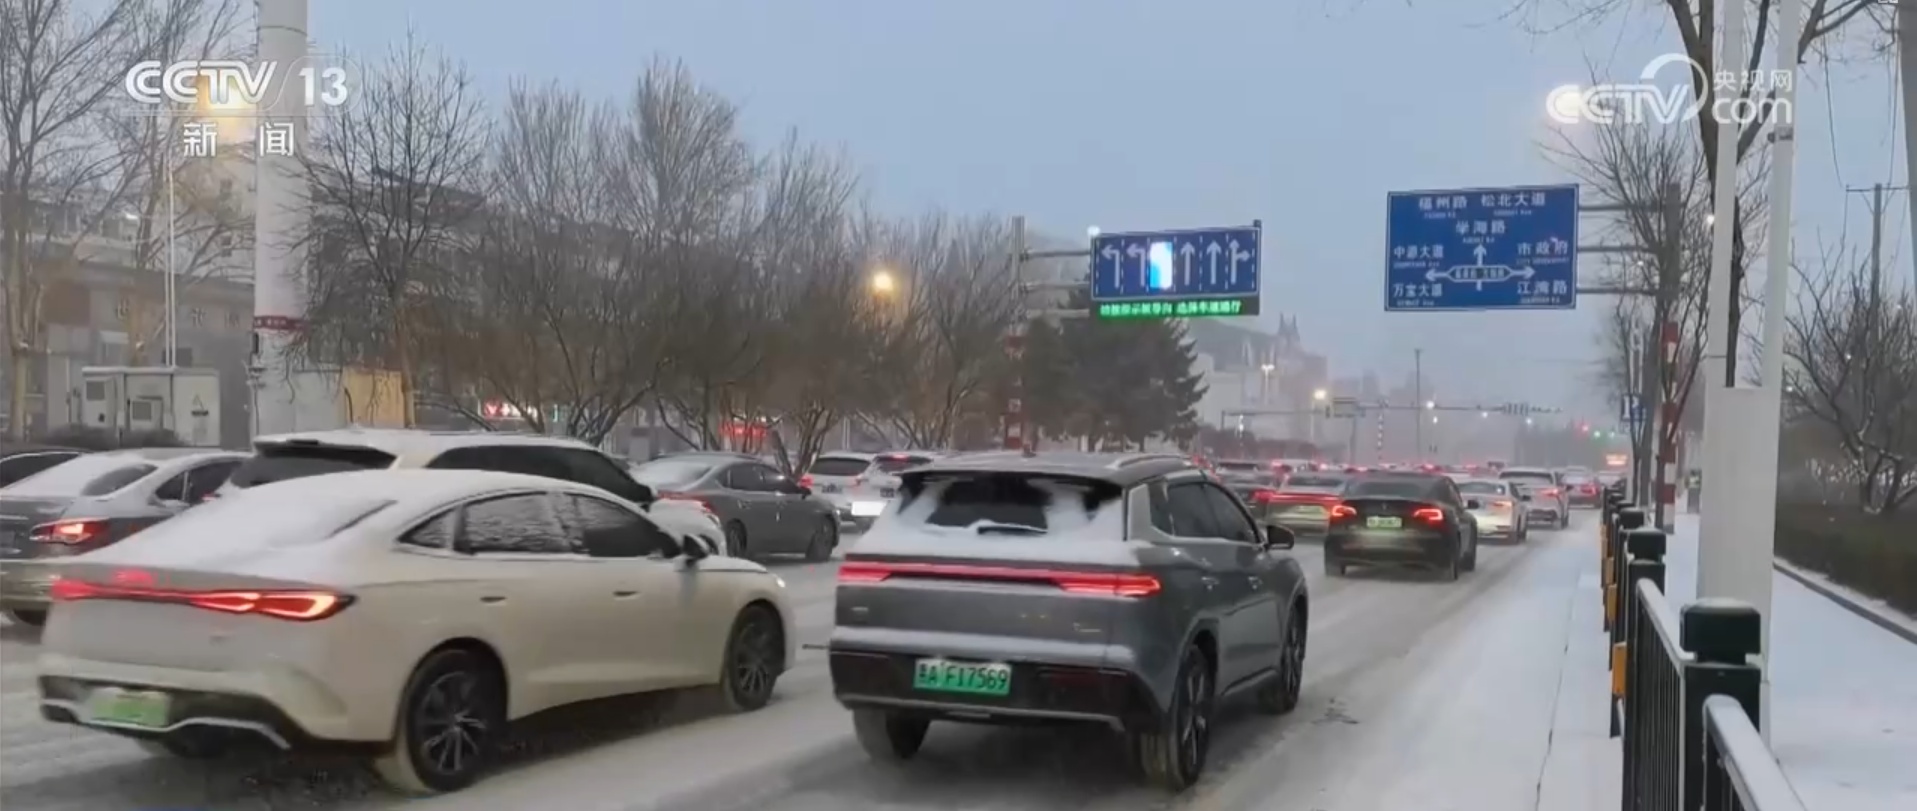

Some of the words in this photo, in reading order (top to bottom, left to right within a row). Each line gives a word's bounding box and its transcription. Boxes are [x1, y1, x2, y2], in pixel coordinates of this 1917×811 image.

[1419, 194, 1468, 211] 福州路
[1480, 191, 1546, 208] 松北大道
[1516, 238, 1568, 255] 市政府
[1393, 282, 1443, 298] 万宝大道
[1516, 279, 1568, 295] 江湾路
